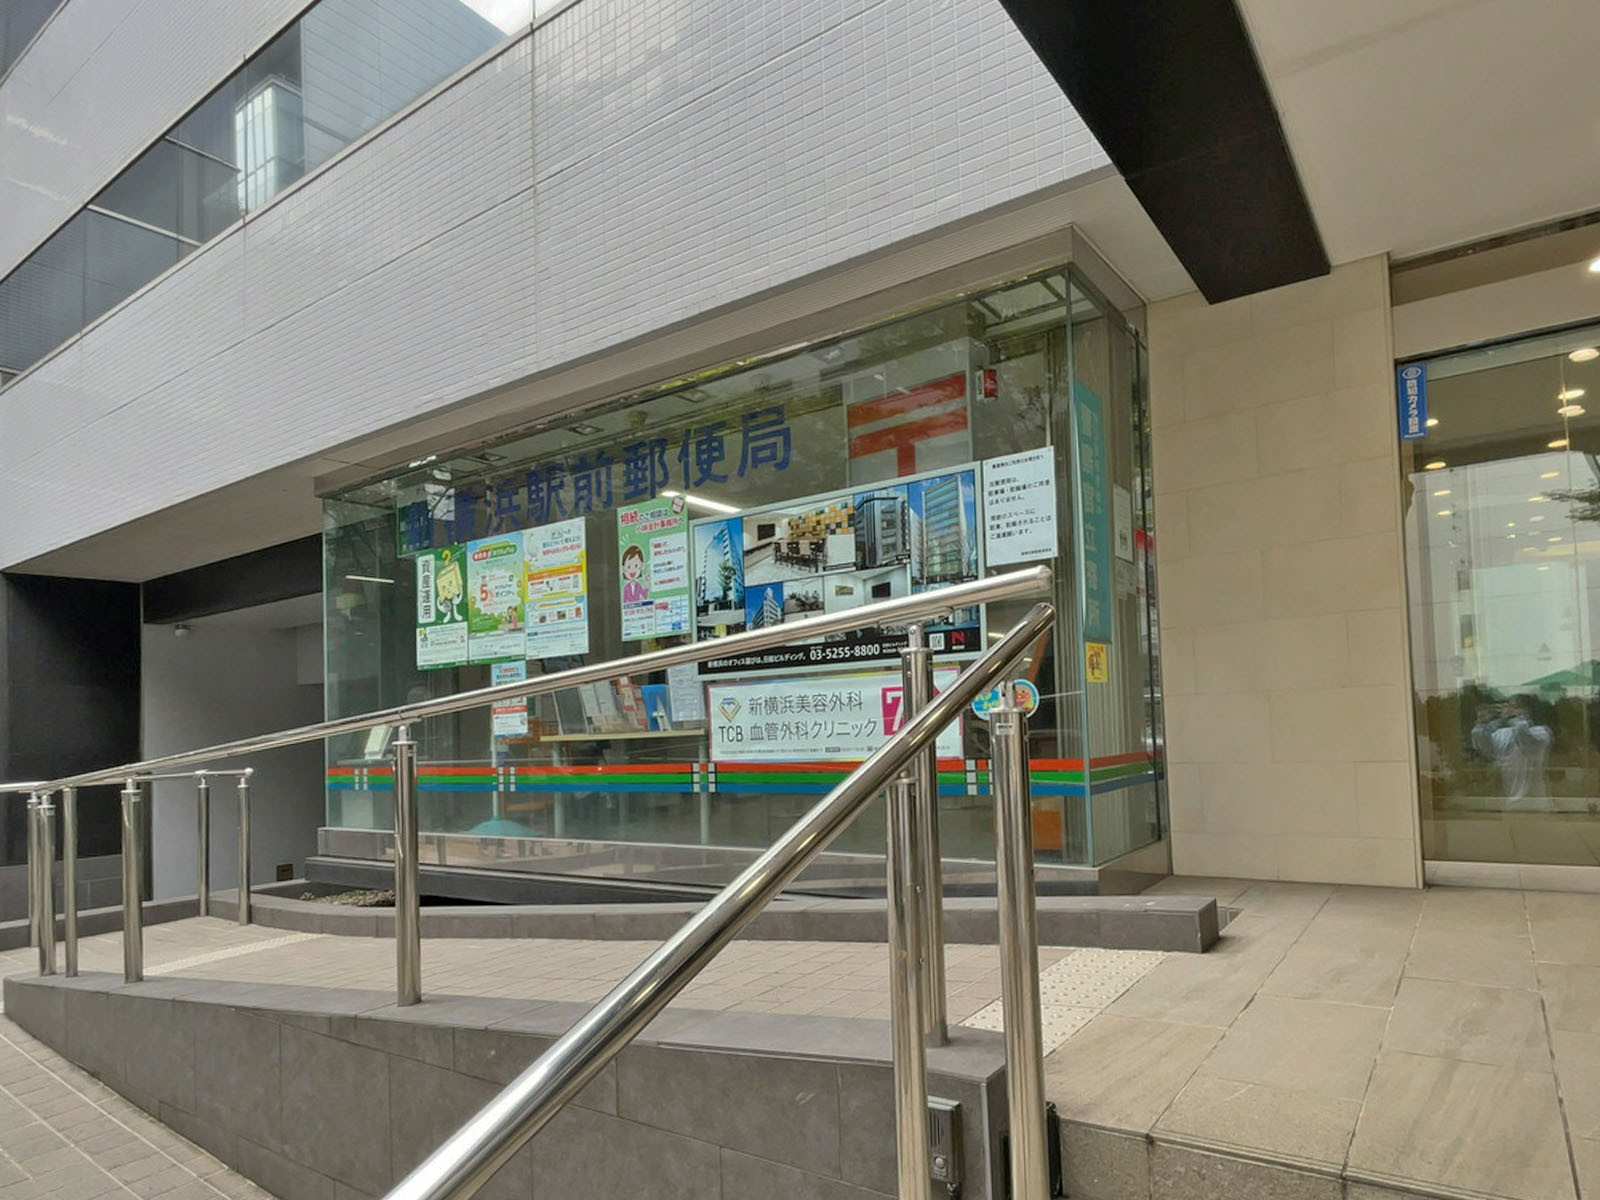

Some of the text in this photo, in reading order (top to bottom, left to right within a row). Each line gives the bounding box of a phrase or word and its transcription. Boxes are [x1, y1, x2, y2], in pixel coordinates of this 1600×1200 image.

[405, 404, 793, 546] 浜駅前郵便局
[809, 643, 880, 661] 03-5255-8800
[748, 690, 863, 716] 新横浜美容外科
[719, 718, 877, 743] TCB 血管外科クリニック
